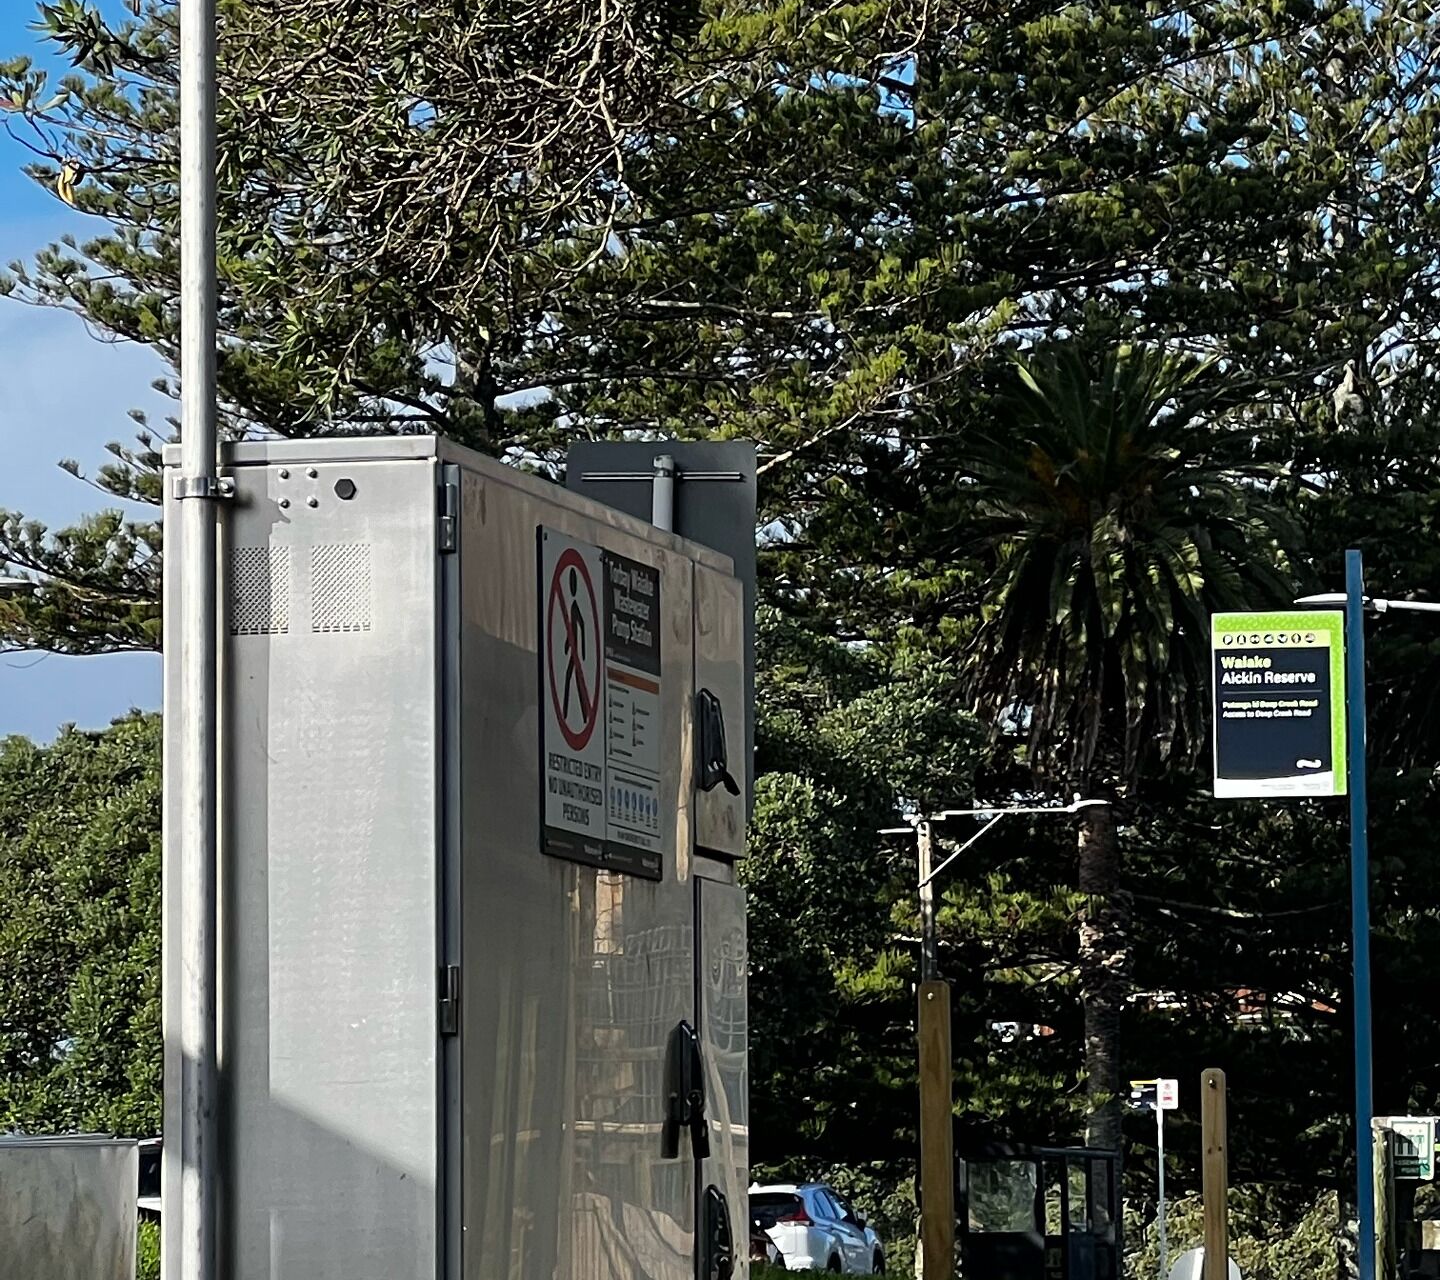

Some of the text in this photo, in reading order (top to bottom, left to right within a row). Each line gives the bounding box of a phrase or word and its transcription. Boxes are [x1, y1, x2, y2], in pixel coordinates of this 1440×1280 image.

[610, 561, 654, 598] Torbay Waiake
[613, 588, 650, 621] Wastewater
[612, 613, 653, 648] Pump Station
[1221, 655, 1272, 669] Waiake
[1221, 671, 1316, 685] Aickin Reserve
[1247, 710, 1254, 718] to
[1255, 709, 1273, 718] Deep
[1273, 709, 1293, 717] Creek
[1293, 708, 1312, 717] Road
[1299, 699, 1319, 707] Road
[548, 752, 602, 782] RESTRICTED ENTRY
[548, 776, 557, 794] NO
[558, 778, 603, 806] UNAUTHORISED
[562, 802, 590, 826] PERSONS
